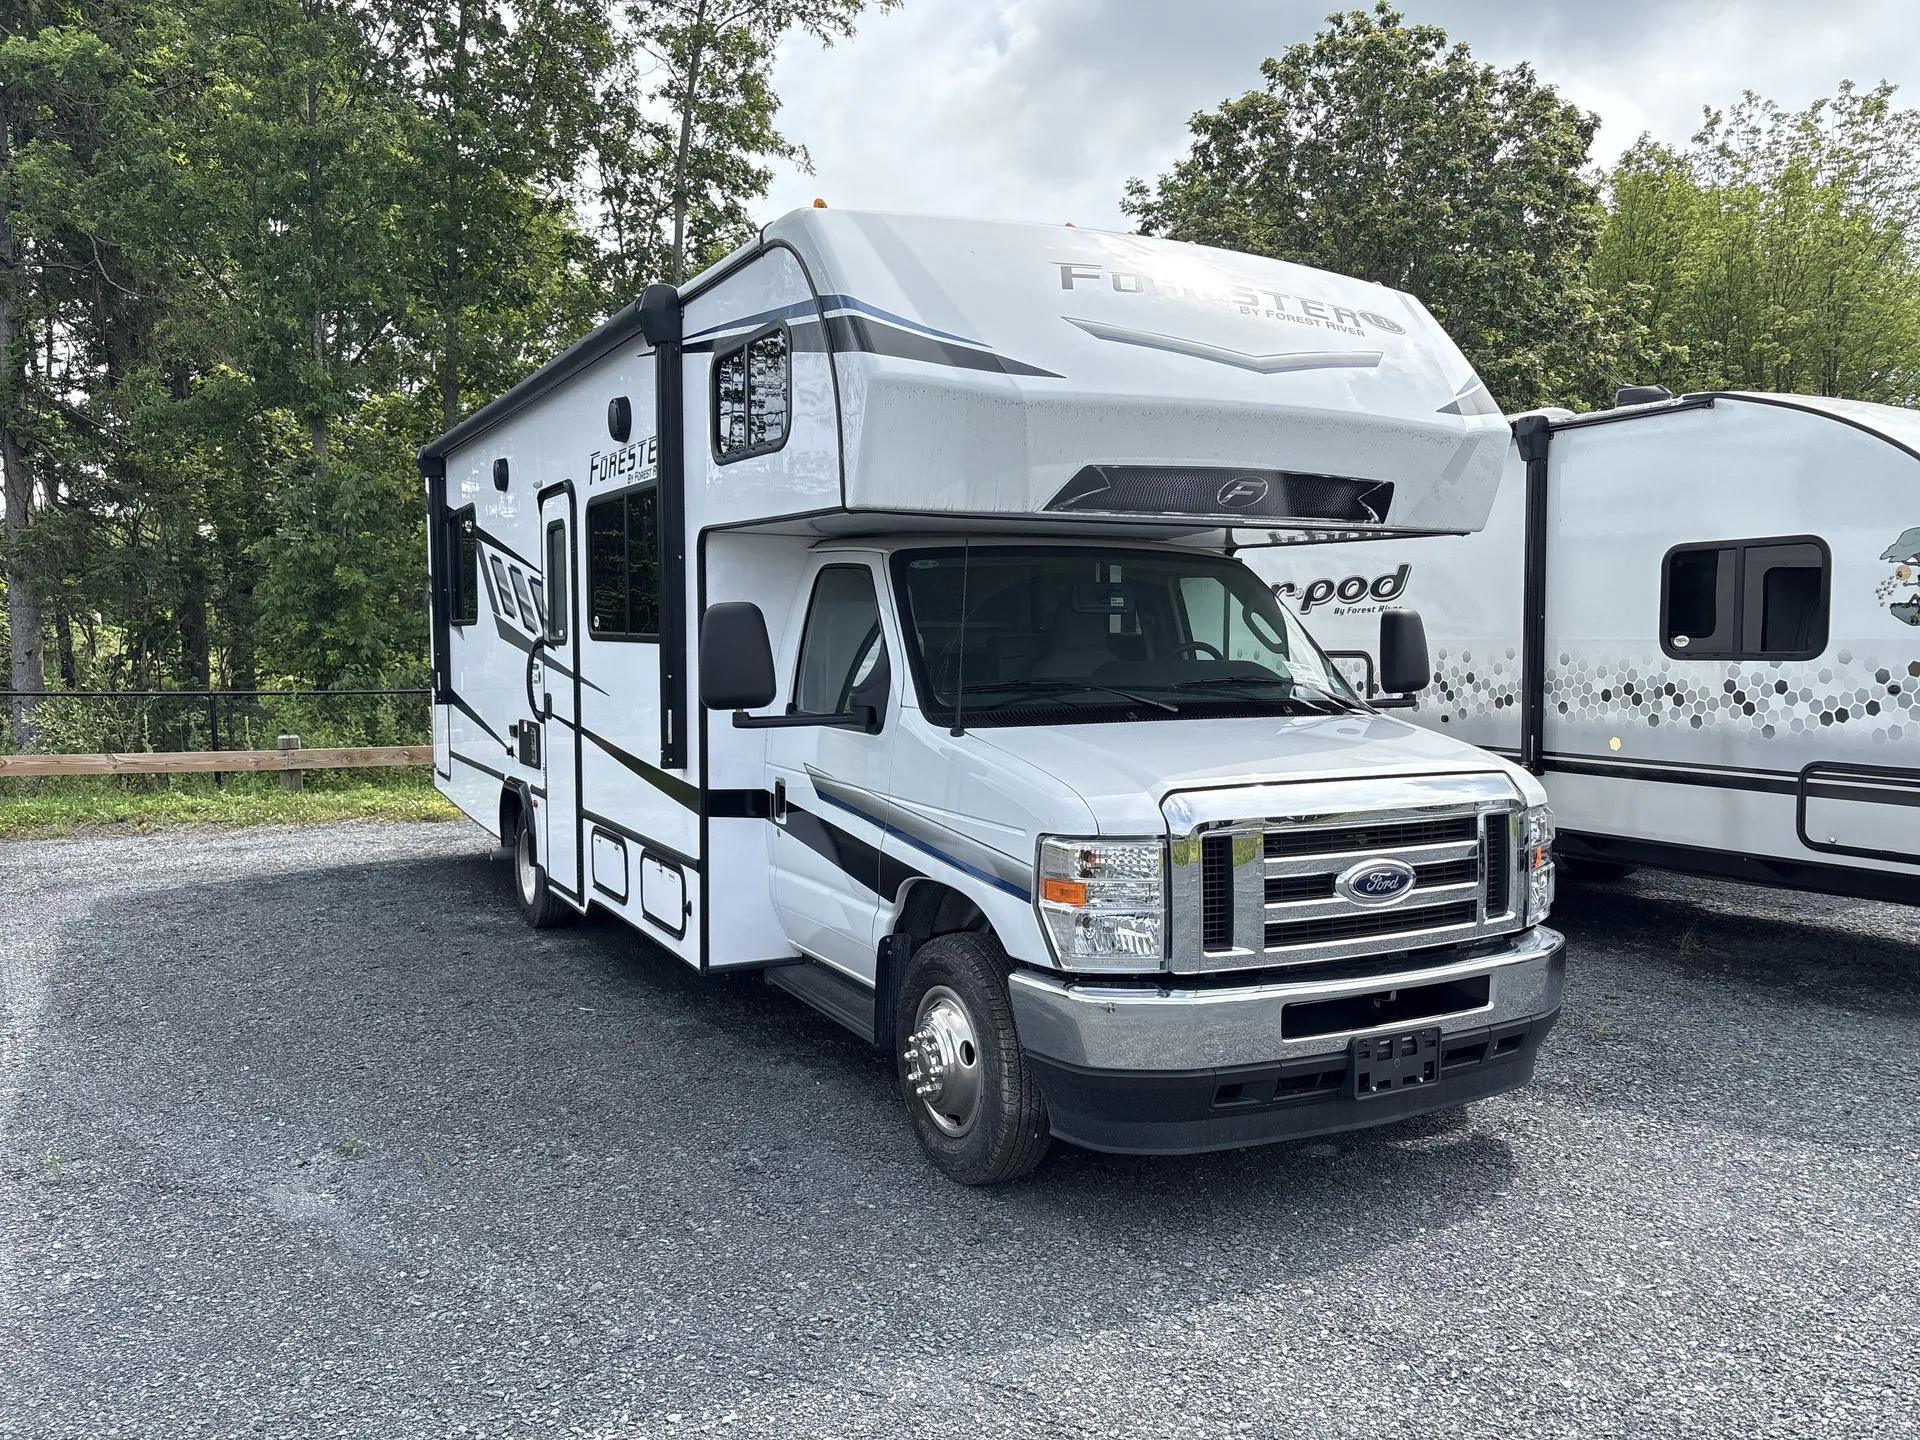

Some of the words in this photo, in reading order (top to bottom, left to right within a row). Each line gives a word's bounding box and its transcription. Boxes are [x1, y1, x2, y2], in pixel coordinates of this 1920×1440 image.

[1050, 262, 1361, 328] FOSTER
[1239, 305, 1260, 316] BY
[1266, 309, 1321, 327] FOREST
[1326, 321, 1366, 338] RIVER
[589, 435, 657, 485] FORESTE
[635, 467, 652, 482] FOREST
[1333, 607, 1345, 616] By
[1347, 606, 1376, 614] Forest
[1366, 872, 1400, 892] Ford
